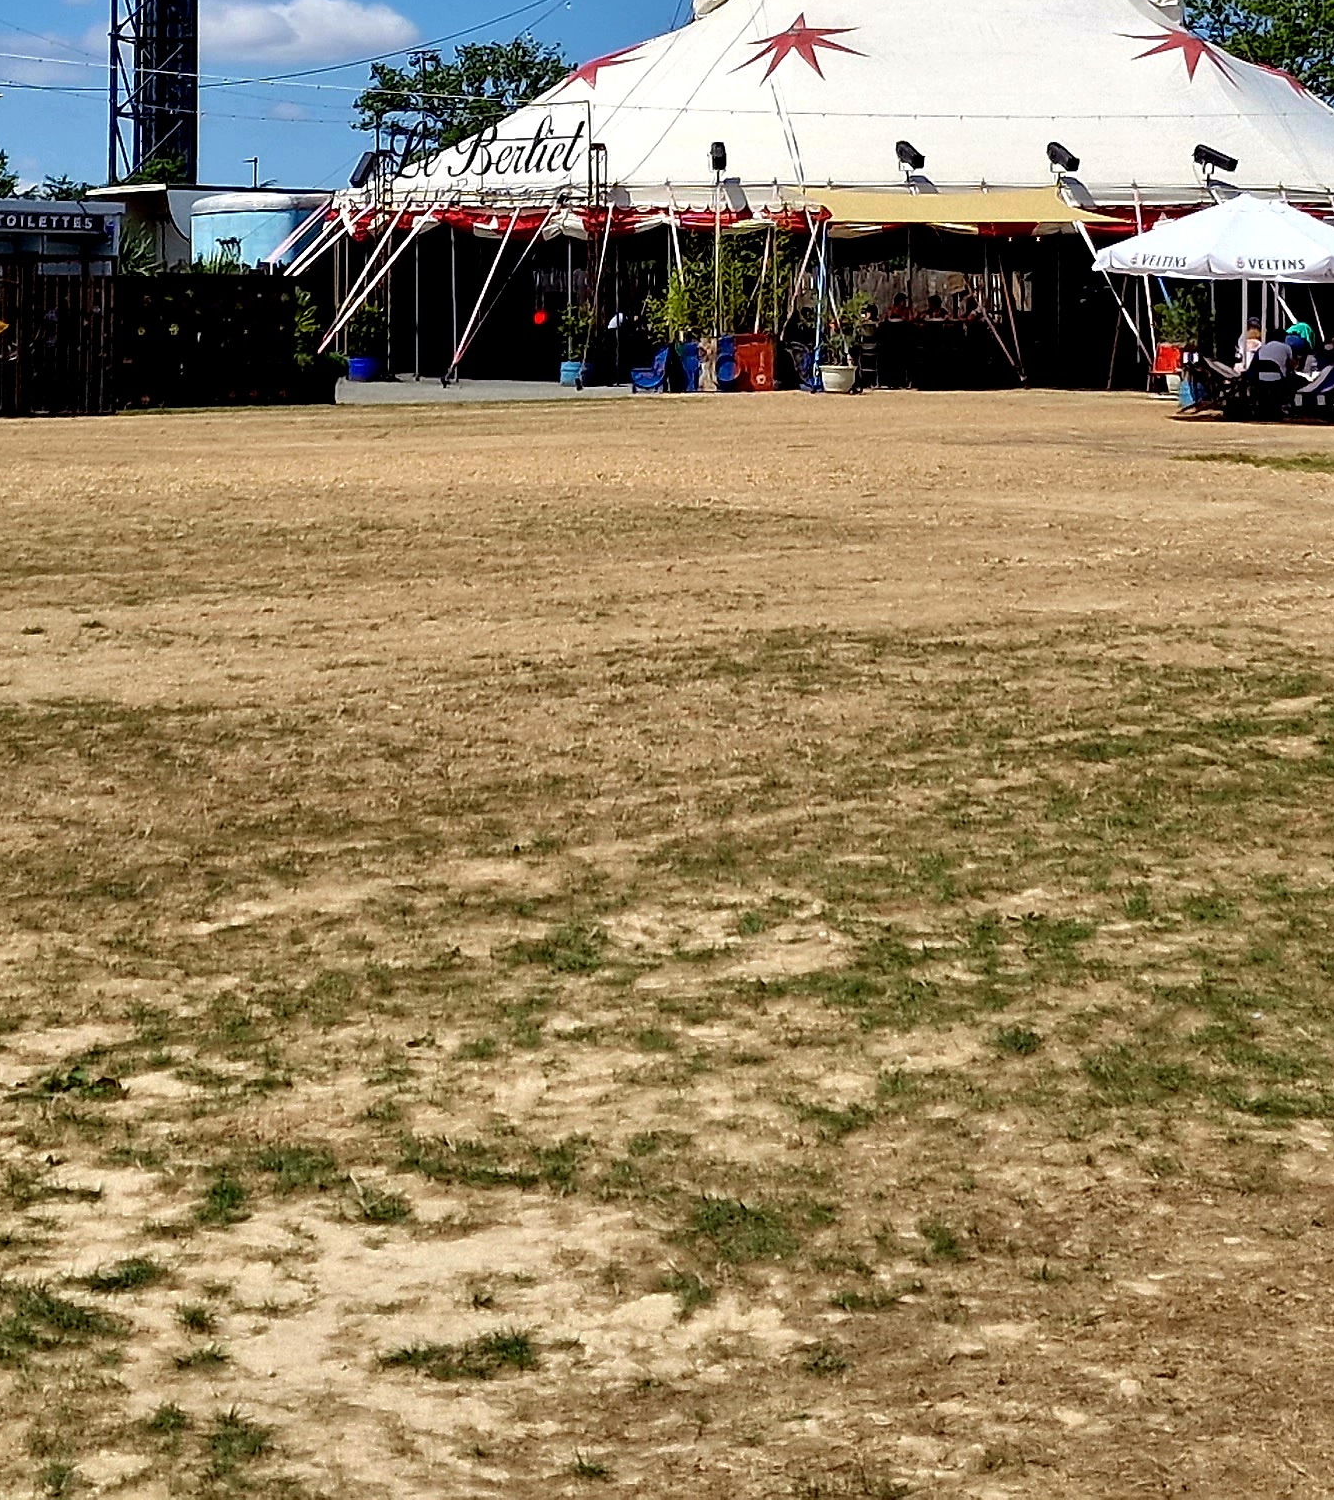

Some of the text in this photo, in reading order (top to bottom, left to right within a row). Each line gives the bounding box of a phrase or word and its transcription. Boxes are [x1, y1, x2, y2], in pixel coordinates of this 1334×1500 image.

[389, 114, 587, 180] Le Berliet
[1141, 253, 1188, 268] VELTINS
[1248, 258, 1306, 270] VELTINS
